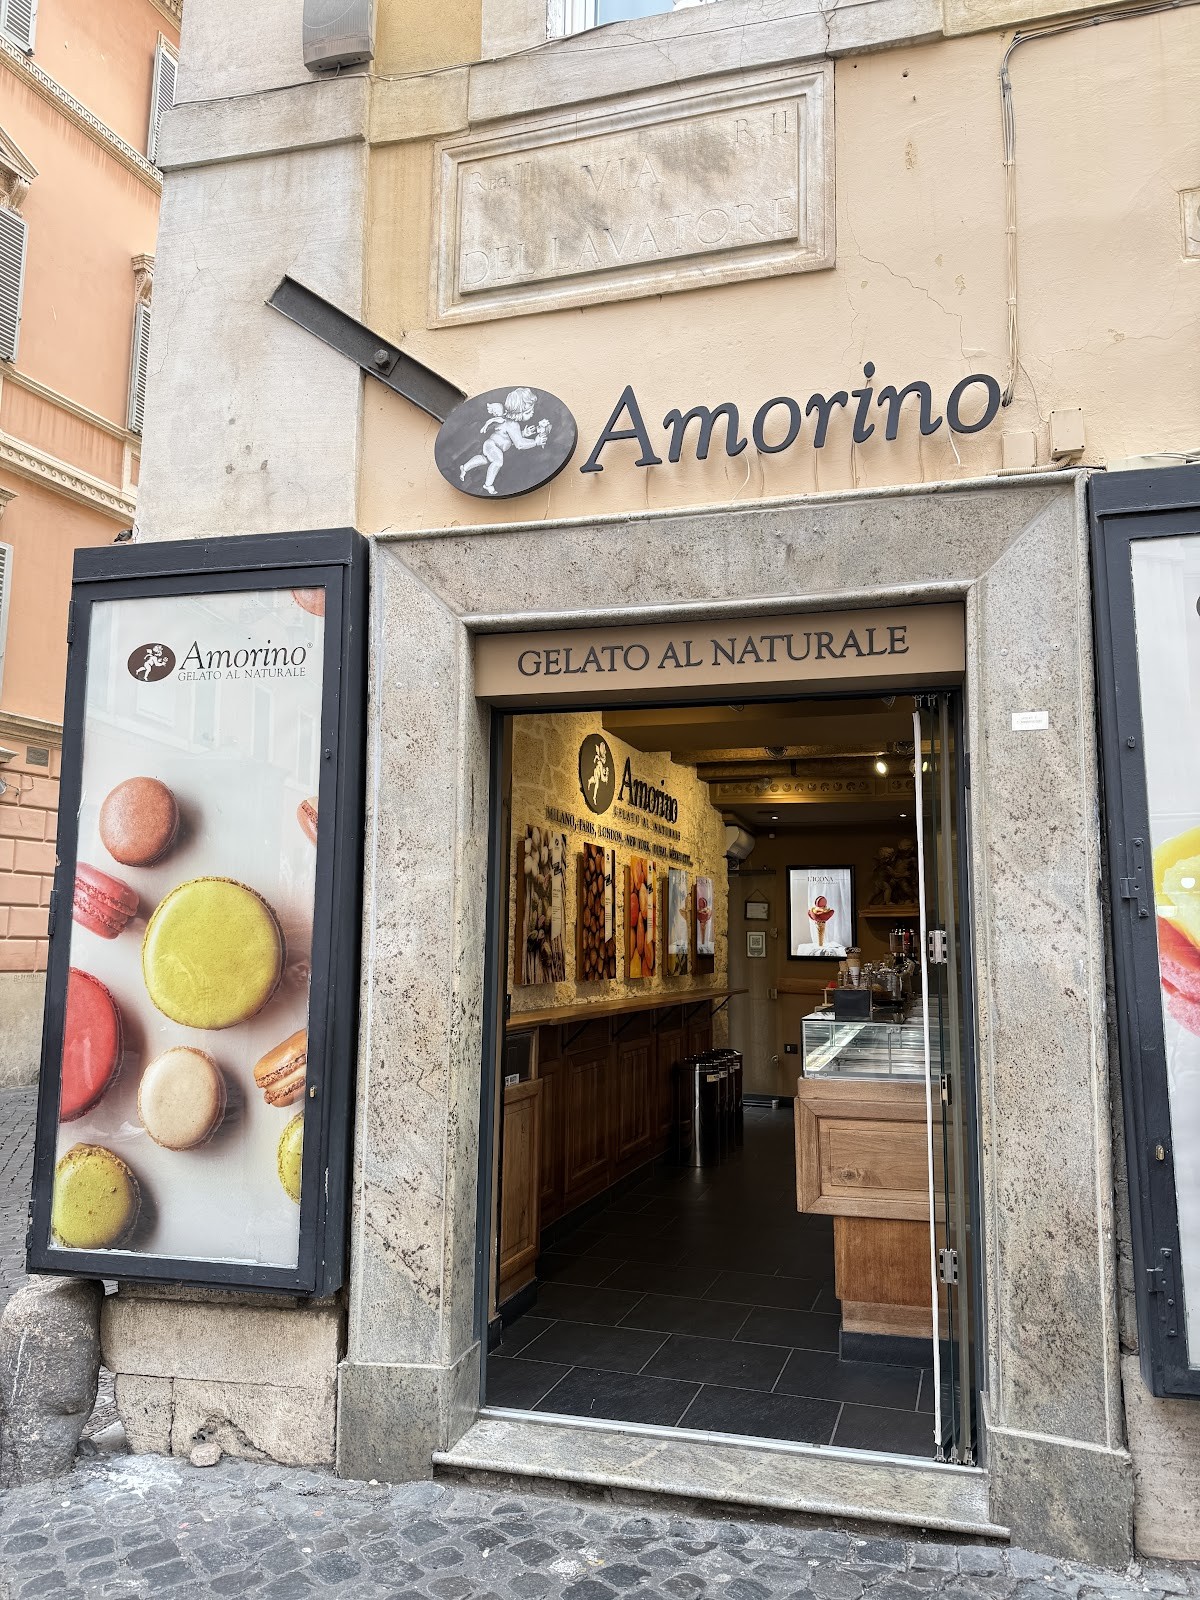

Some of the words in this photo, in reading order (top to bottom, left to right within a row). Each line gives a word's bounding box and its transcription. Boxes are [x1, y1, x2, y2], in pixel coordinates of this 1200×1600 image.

[770, 110, 789, 136] II
[580, 153, 663, 193] VIA
[462, 242, 537, 286] DEL
[551, 196, 796, 272] LAVATORE
[579, 361, 1002, 474] Amorino
[177, 670, 223, 682] GELATO
[225, 669, 241, 680] AL
[244, 667, 307, 679] NATURALE
[517, 643, 650, 677] GELATO
[657, 640, 704, 669] AL
[711, 625, 910, 667] NATURALE
[616, 756, 678, 824] Amorino
